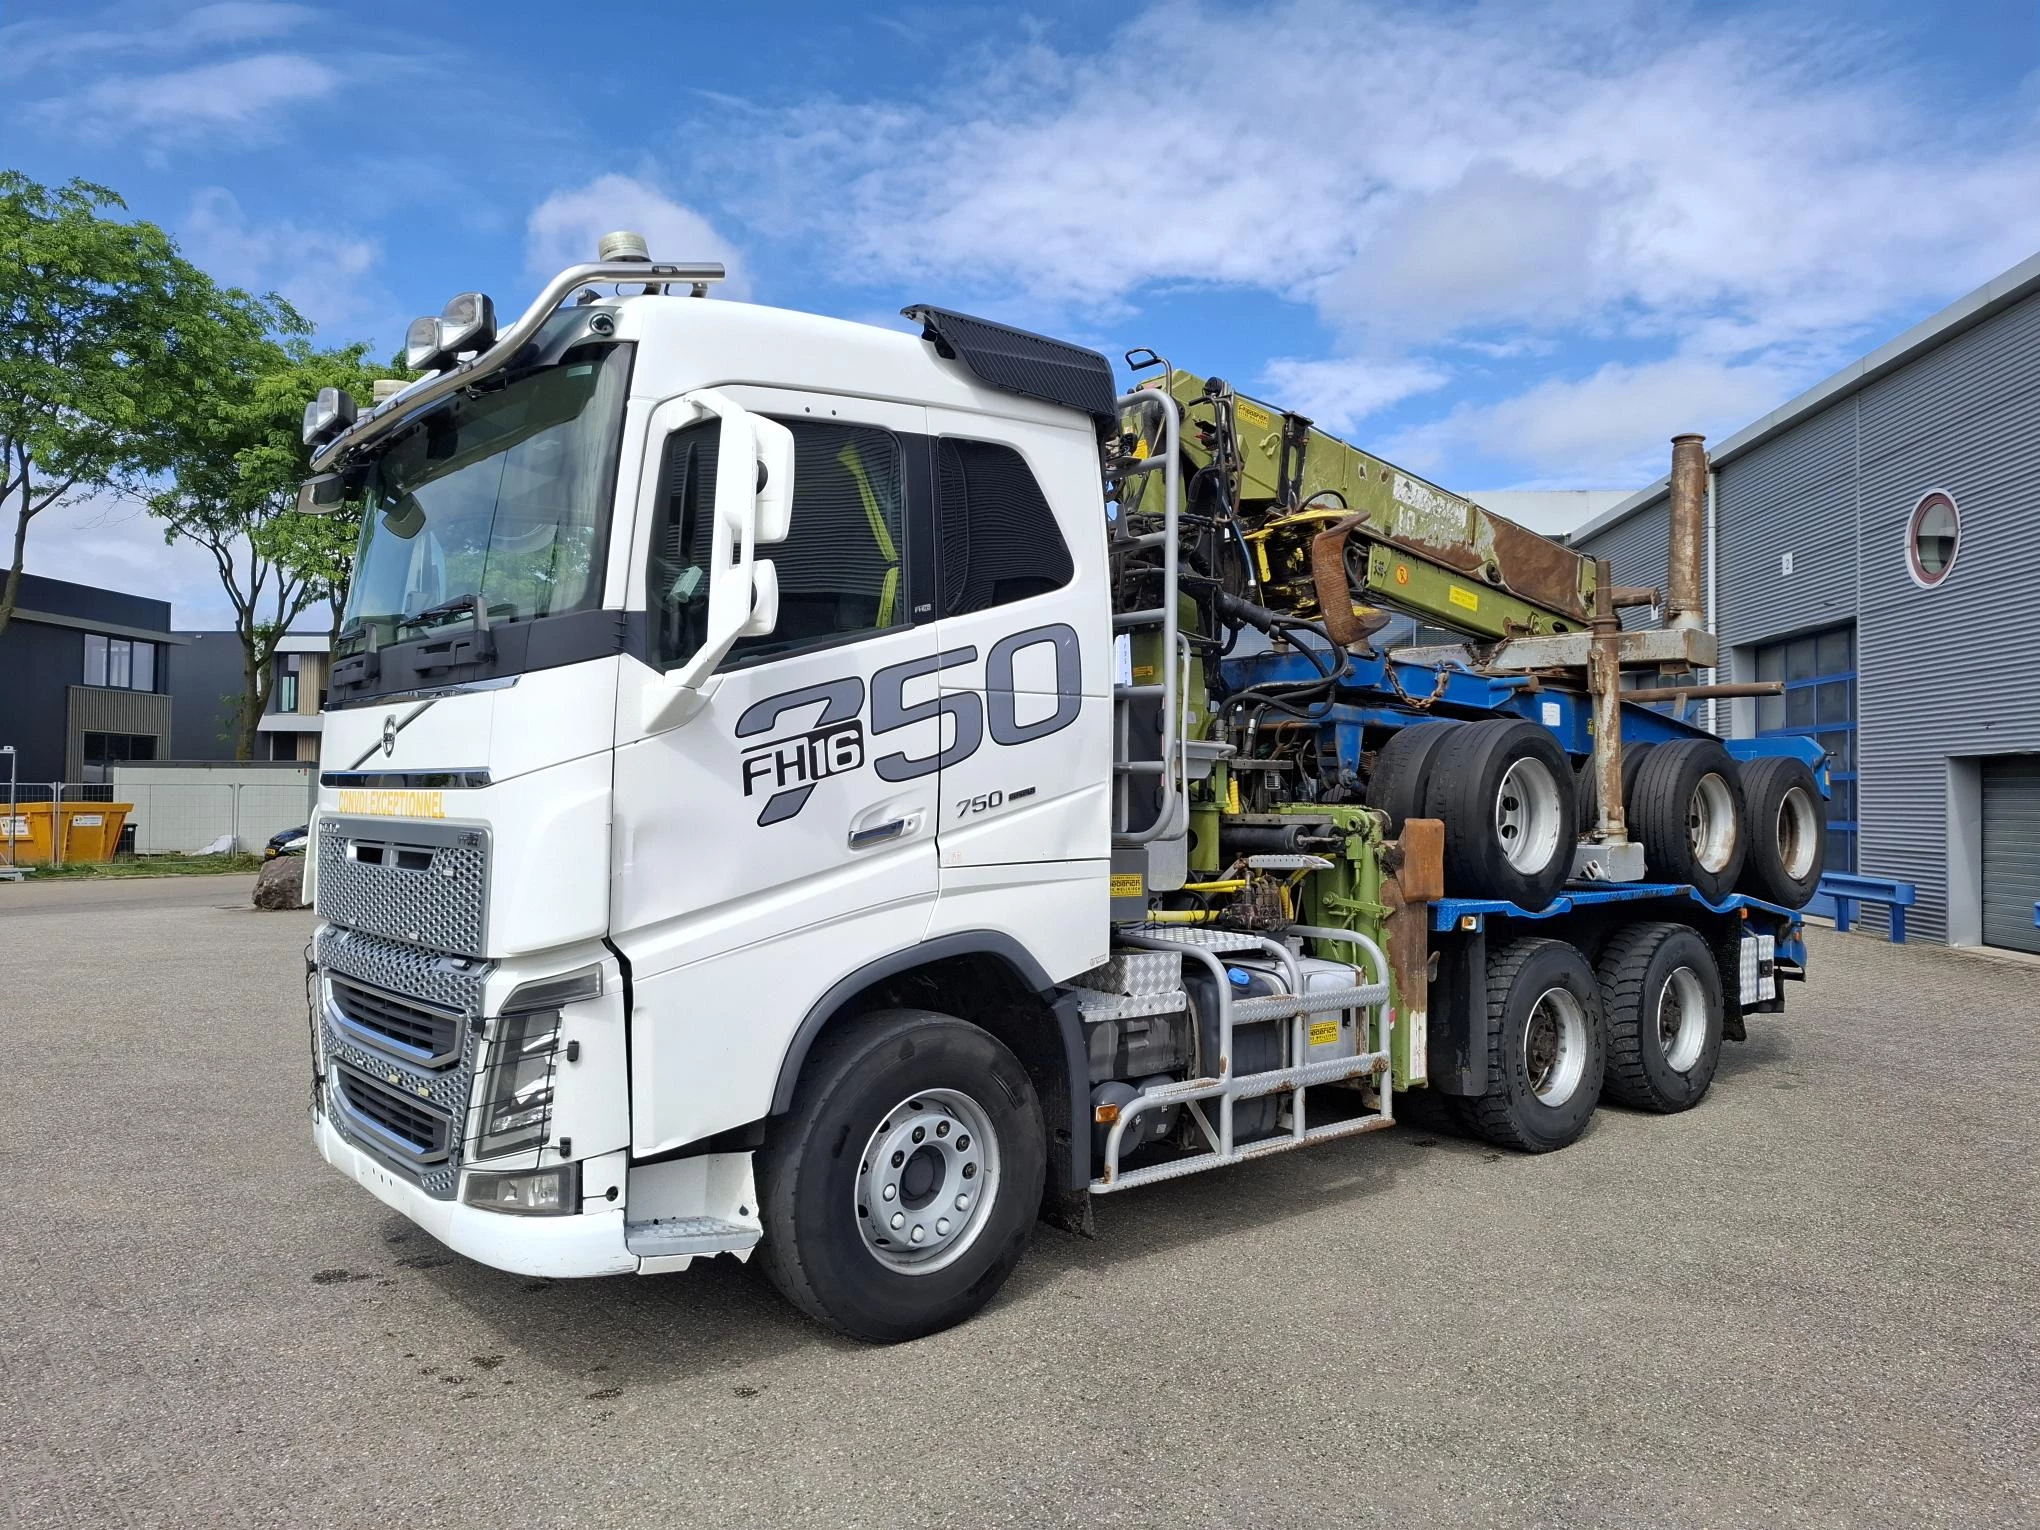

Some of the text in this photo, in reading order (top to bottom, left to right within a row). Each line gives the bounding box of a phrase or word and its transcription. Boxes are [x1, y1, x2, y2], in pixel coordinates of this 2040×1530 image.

[735, 623, 1082, 827] 750
[741, 724, 864, 798] FH16
[338, 790, 446, 819] CONVOI EXCEPTIONNEL
[956, 789, 1003, 818] 750
